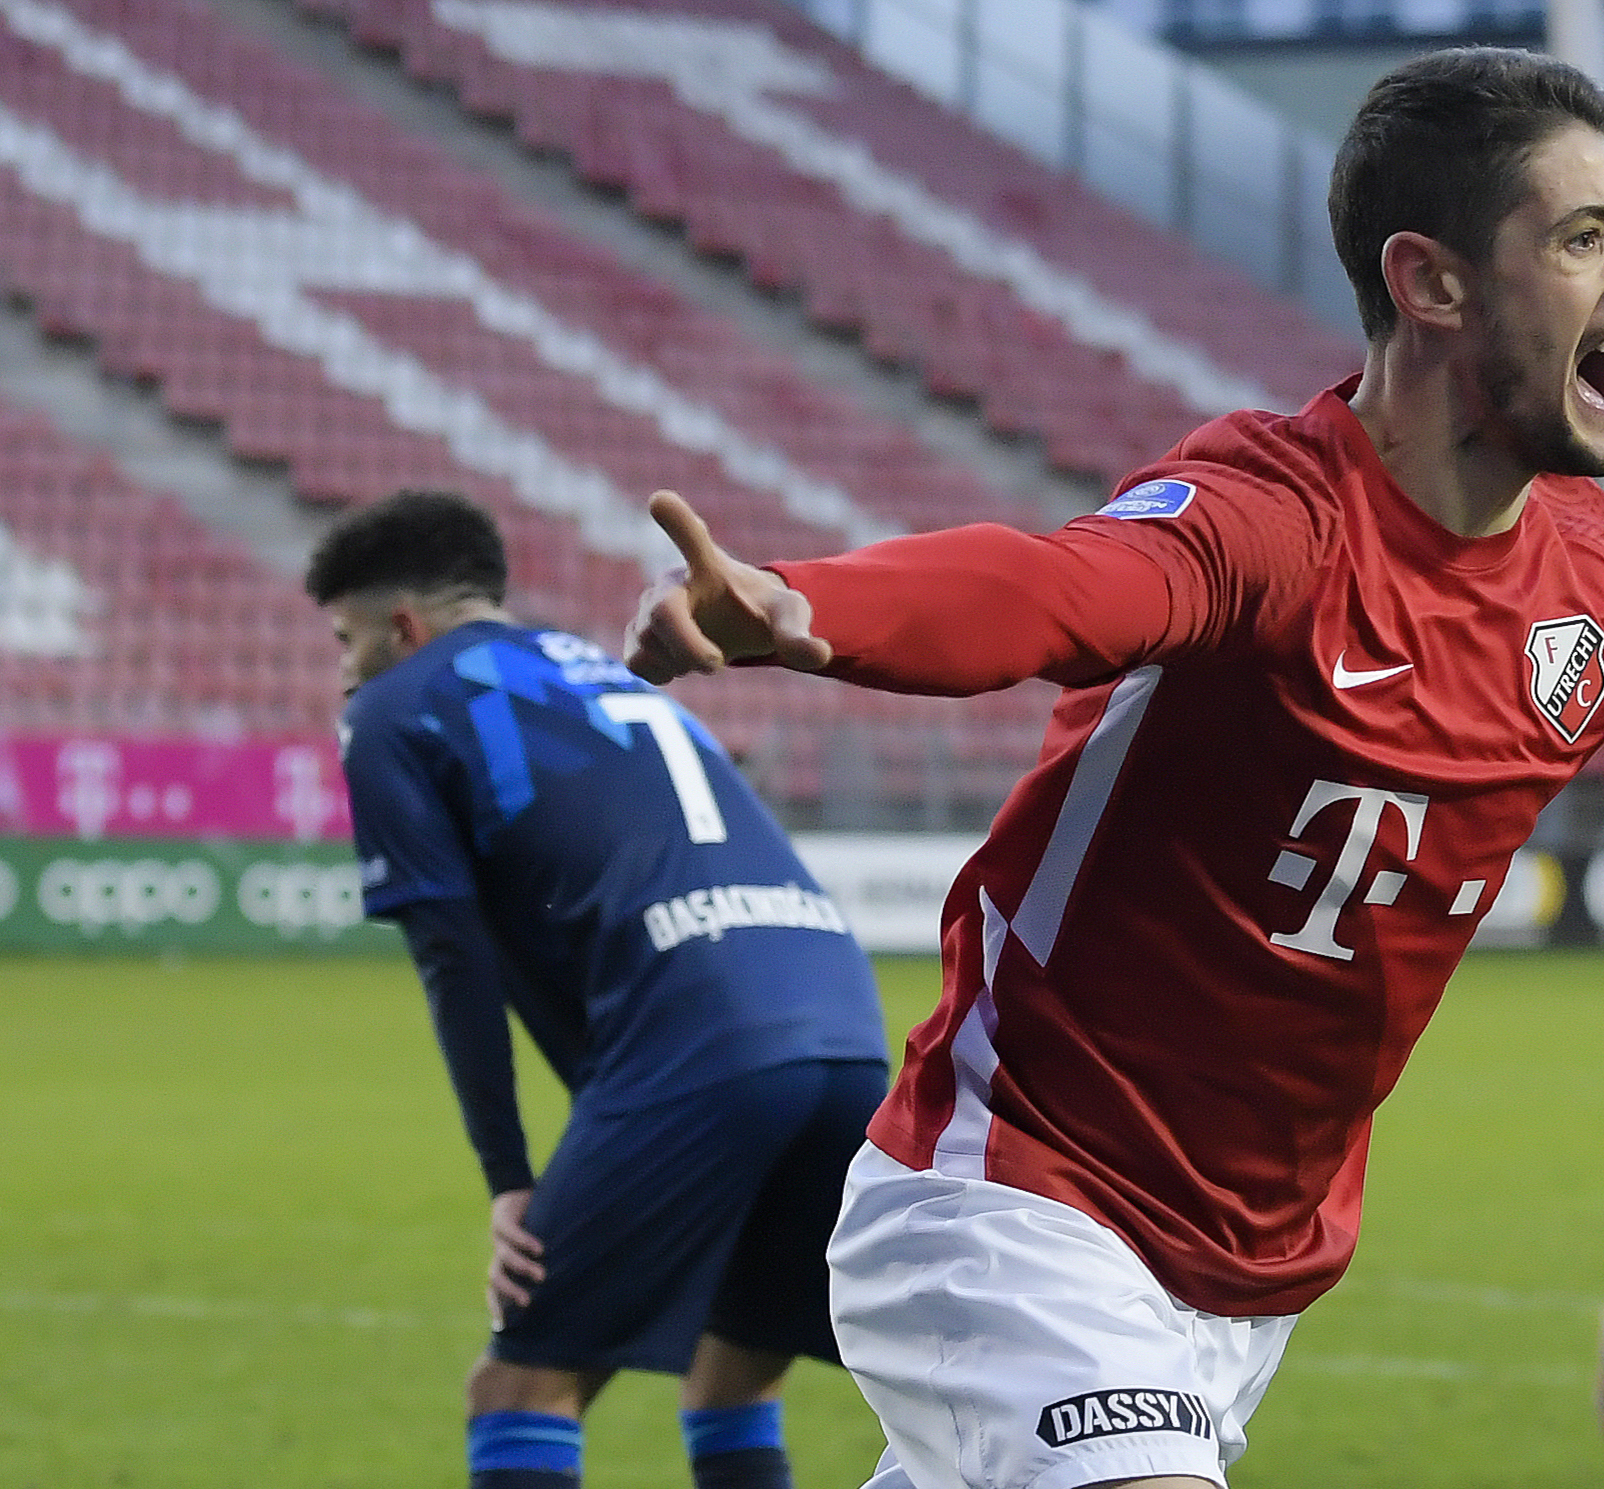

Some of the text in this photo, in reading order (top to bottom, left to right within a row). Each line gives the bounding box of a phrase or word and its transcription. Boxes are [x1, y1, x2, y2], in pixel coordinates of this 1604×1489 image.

[1544, 636, 1559, 664] F
[1546, 626, 1598, 717] UTRECHT
[1576, 679, 1592, 708] C
[599, 691, 728, 844] 7
[38, 858, 222, 940] oppo
[237, 859, 364, 942] opp
[1050, 1392, 1182, 1442] DASSY
